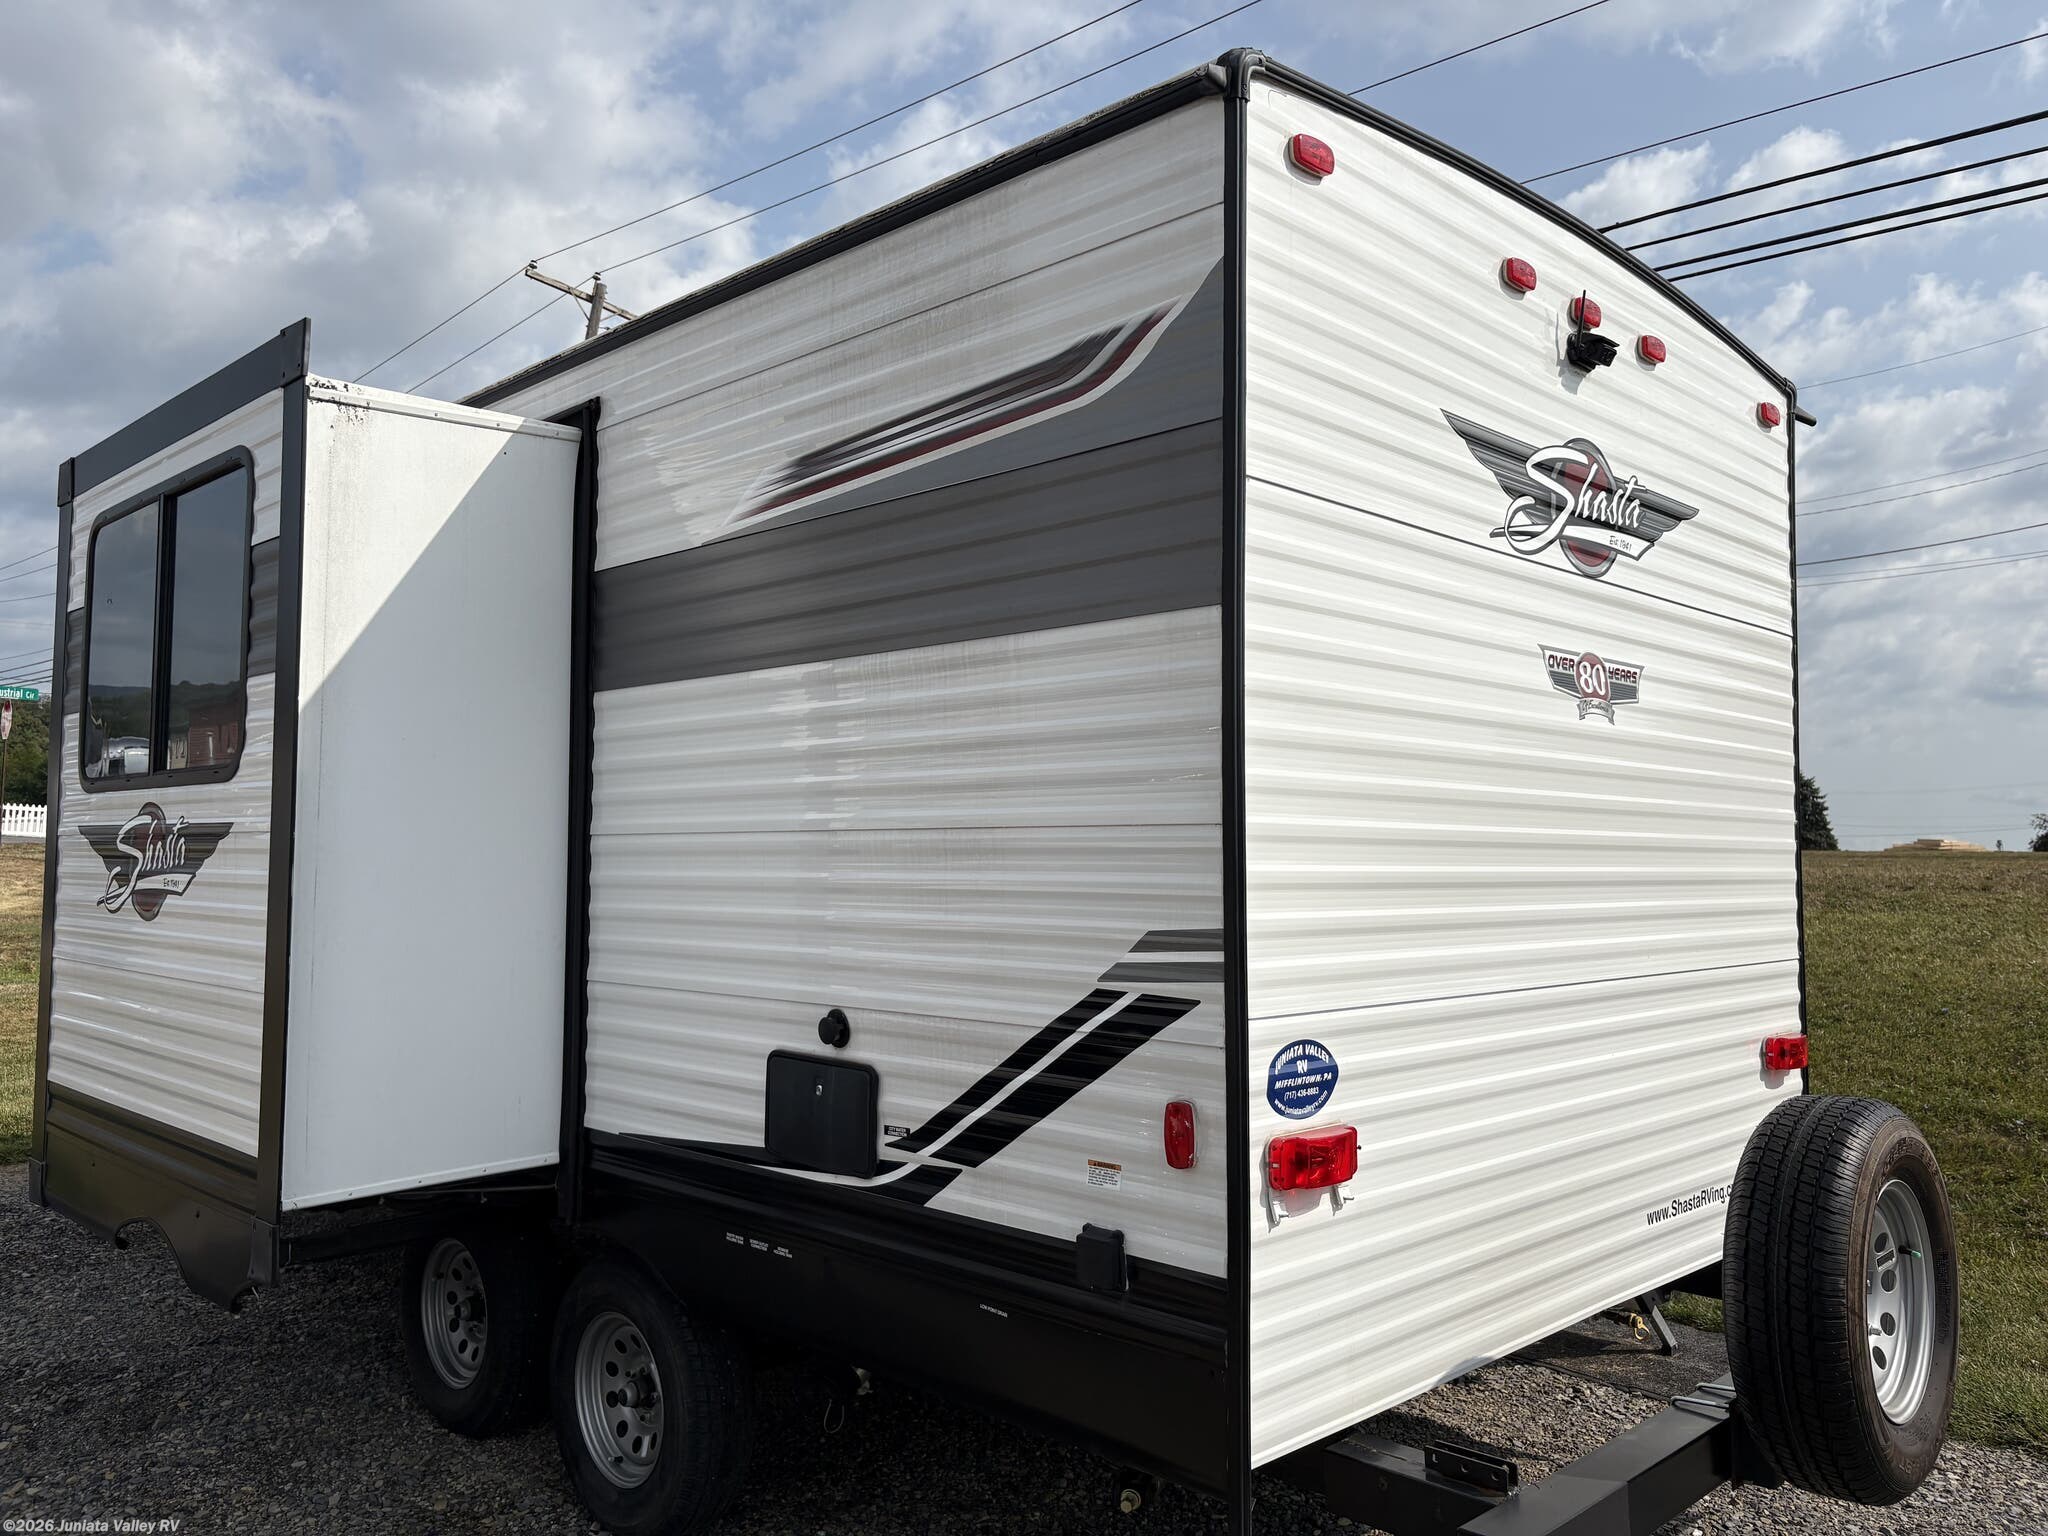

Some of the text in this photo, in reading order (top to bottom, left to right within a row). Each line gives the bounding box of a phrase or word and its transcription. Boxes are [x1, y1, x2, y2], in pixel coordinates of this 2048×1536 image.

[1504, 445, 1647, 556] Shasta
[1547, 654, 1638, 696] OVER 80 YEARS
[0, 688, 35, 699] ustrial Cir
[104, 815, 190, 913] Shasta
[1274, 1044, 1330, 1075] JUNIATA VALLEY
[1296, 1059, 1308, 1074] RV
[1323, 1072, 1332, 1081] PA
[1274, 1090, 1328, 1115] www.juniatavalleyrv.com
[1284, 1091, 1297, 1101] (717)
[1646, 1184, 1733, 1226] www.ShastaRVing.c
